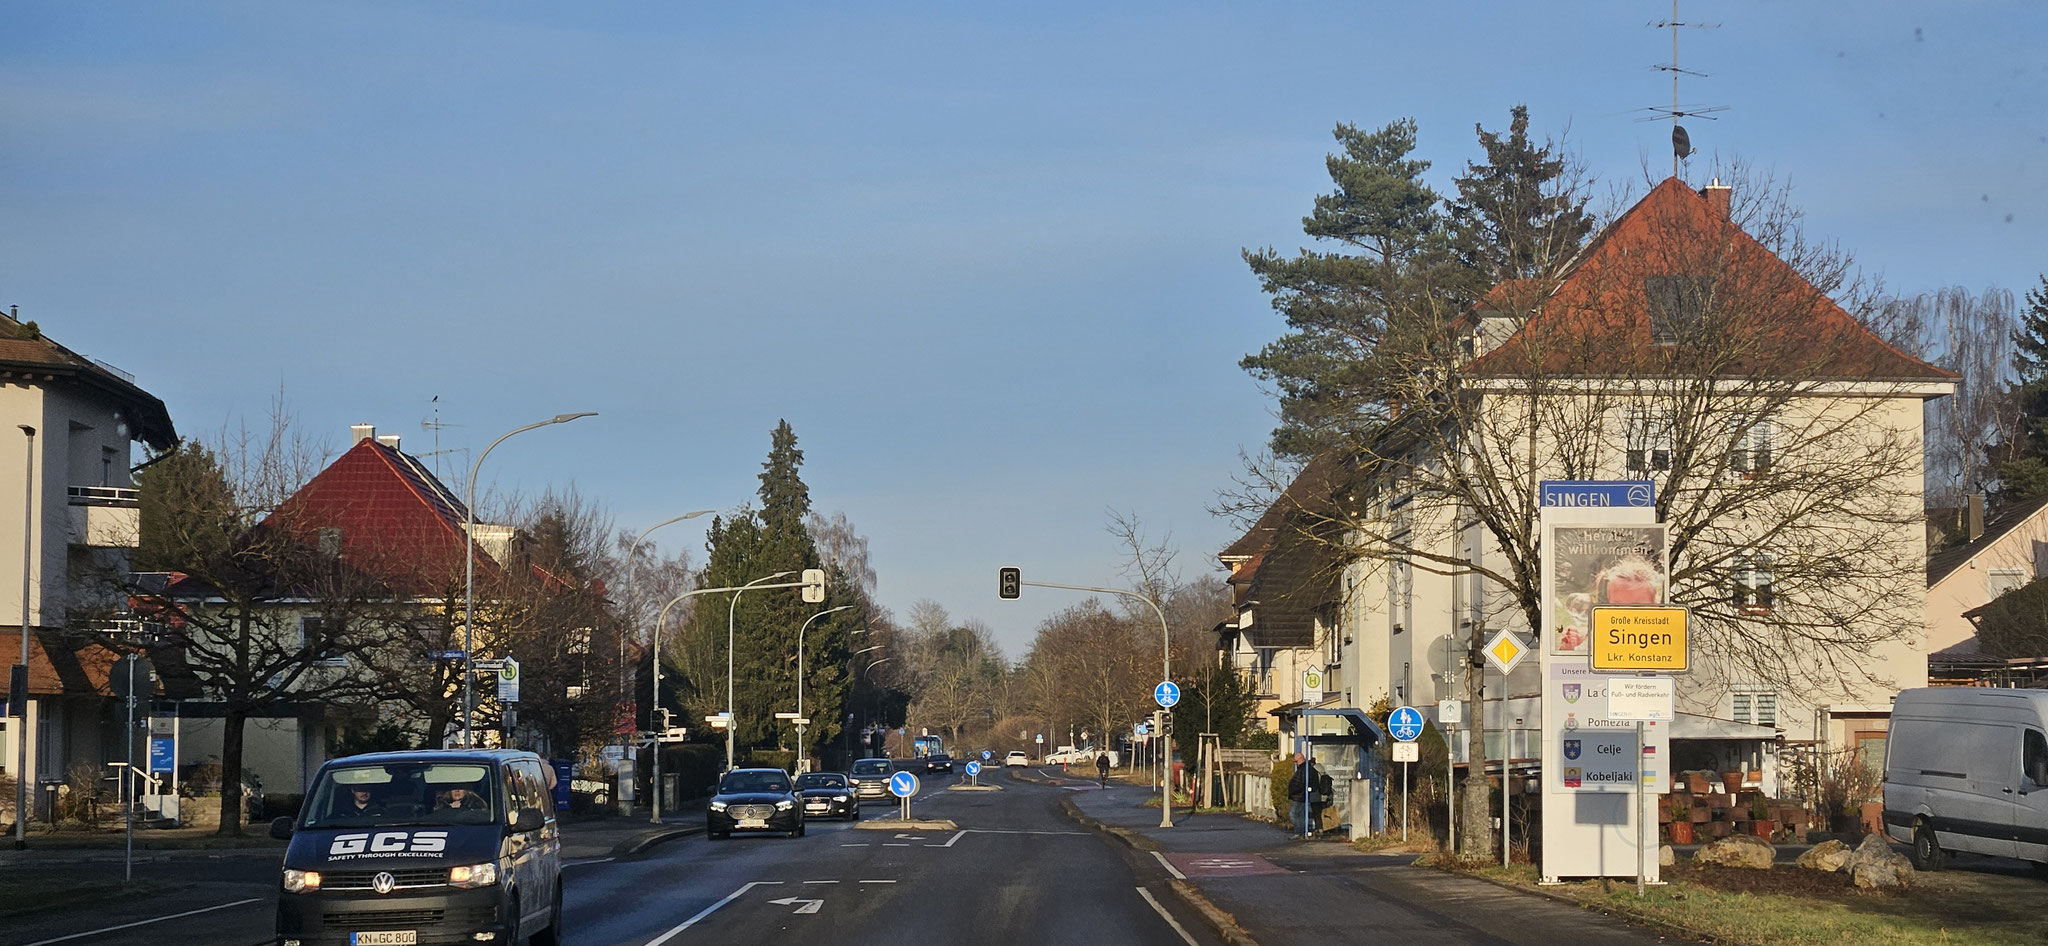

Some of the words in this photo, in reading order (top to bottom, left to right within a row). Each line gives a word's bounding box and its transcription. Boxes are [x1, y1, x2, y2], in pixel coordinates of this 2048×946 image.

[1546, 492, 1610, 507] SINGEN
[1610, 616, 1631, 625] Große
[1634, 616, 1669, 625] Kreisstadt
[1609, 629, 1671, 649] Singen
[1607, 653, 1625, 662] Lkr.
[1629, 653, 1672, 662] Konstanz
[1587, 688, 1598, 698] La
[1588, 718, 1630, 727] Pomezia
[1597, 744, 1622, 756] Celje
[1586, 771, 1633, 783] Kobeljaki
[329, 831, 449, 855] GCS
[328, 854, 356, 862] SAFETY
[357, 933, 372, 944] KN
[379, 933, 393, 943] GC
[395, 932, 415, 943] 800
